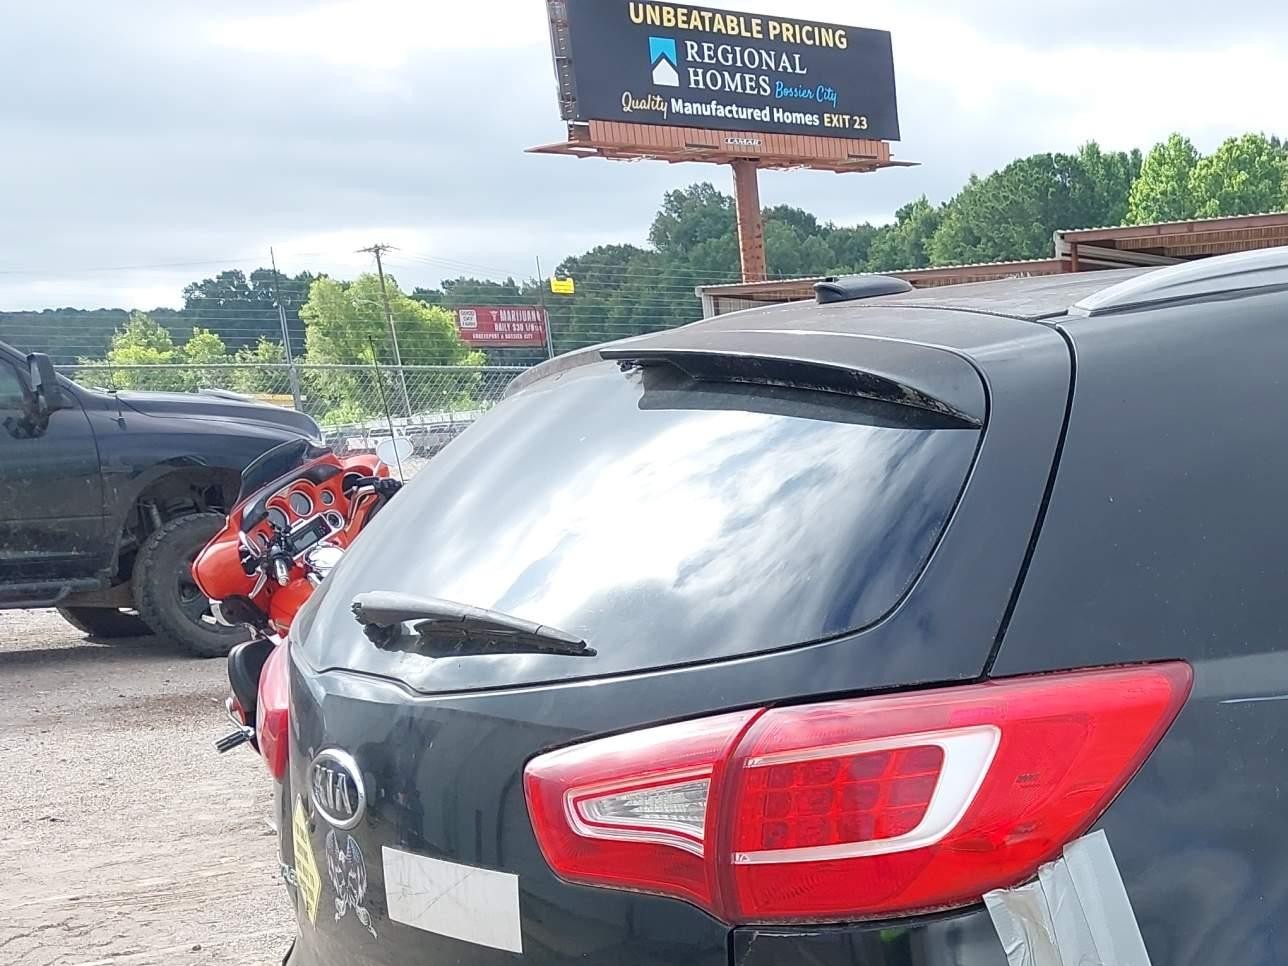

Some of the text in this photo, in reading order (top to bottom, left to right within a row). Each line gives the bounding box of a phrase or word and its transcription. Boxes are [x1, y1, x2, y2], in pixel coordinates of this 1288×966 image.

[629, 2, 848, 49] UNBEATABLE PRICING
[684, 40, 807, 74] REGIONAL
[687, 67, 771, 96] HOMES
[775, 80, 837, 109] Bossier City
[621, 91, 868, 130] Quality Manufactured Homes EXIT 23
[314, 764, 353, 815] KIA
